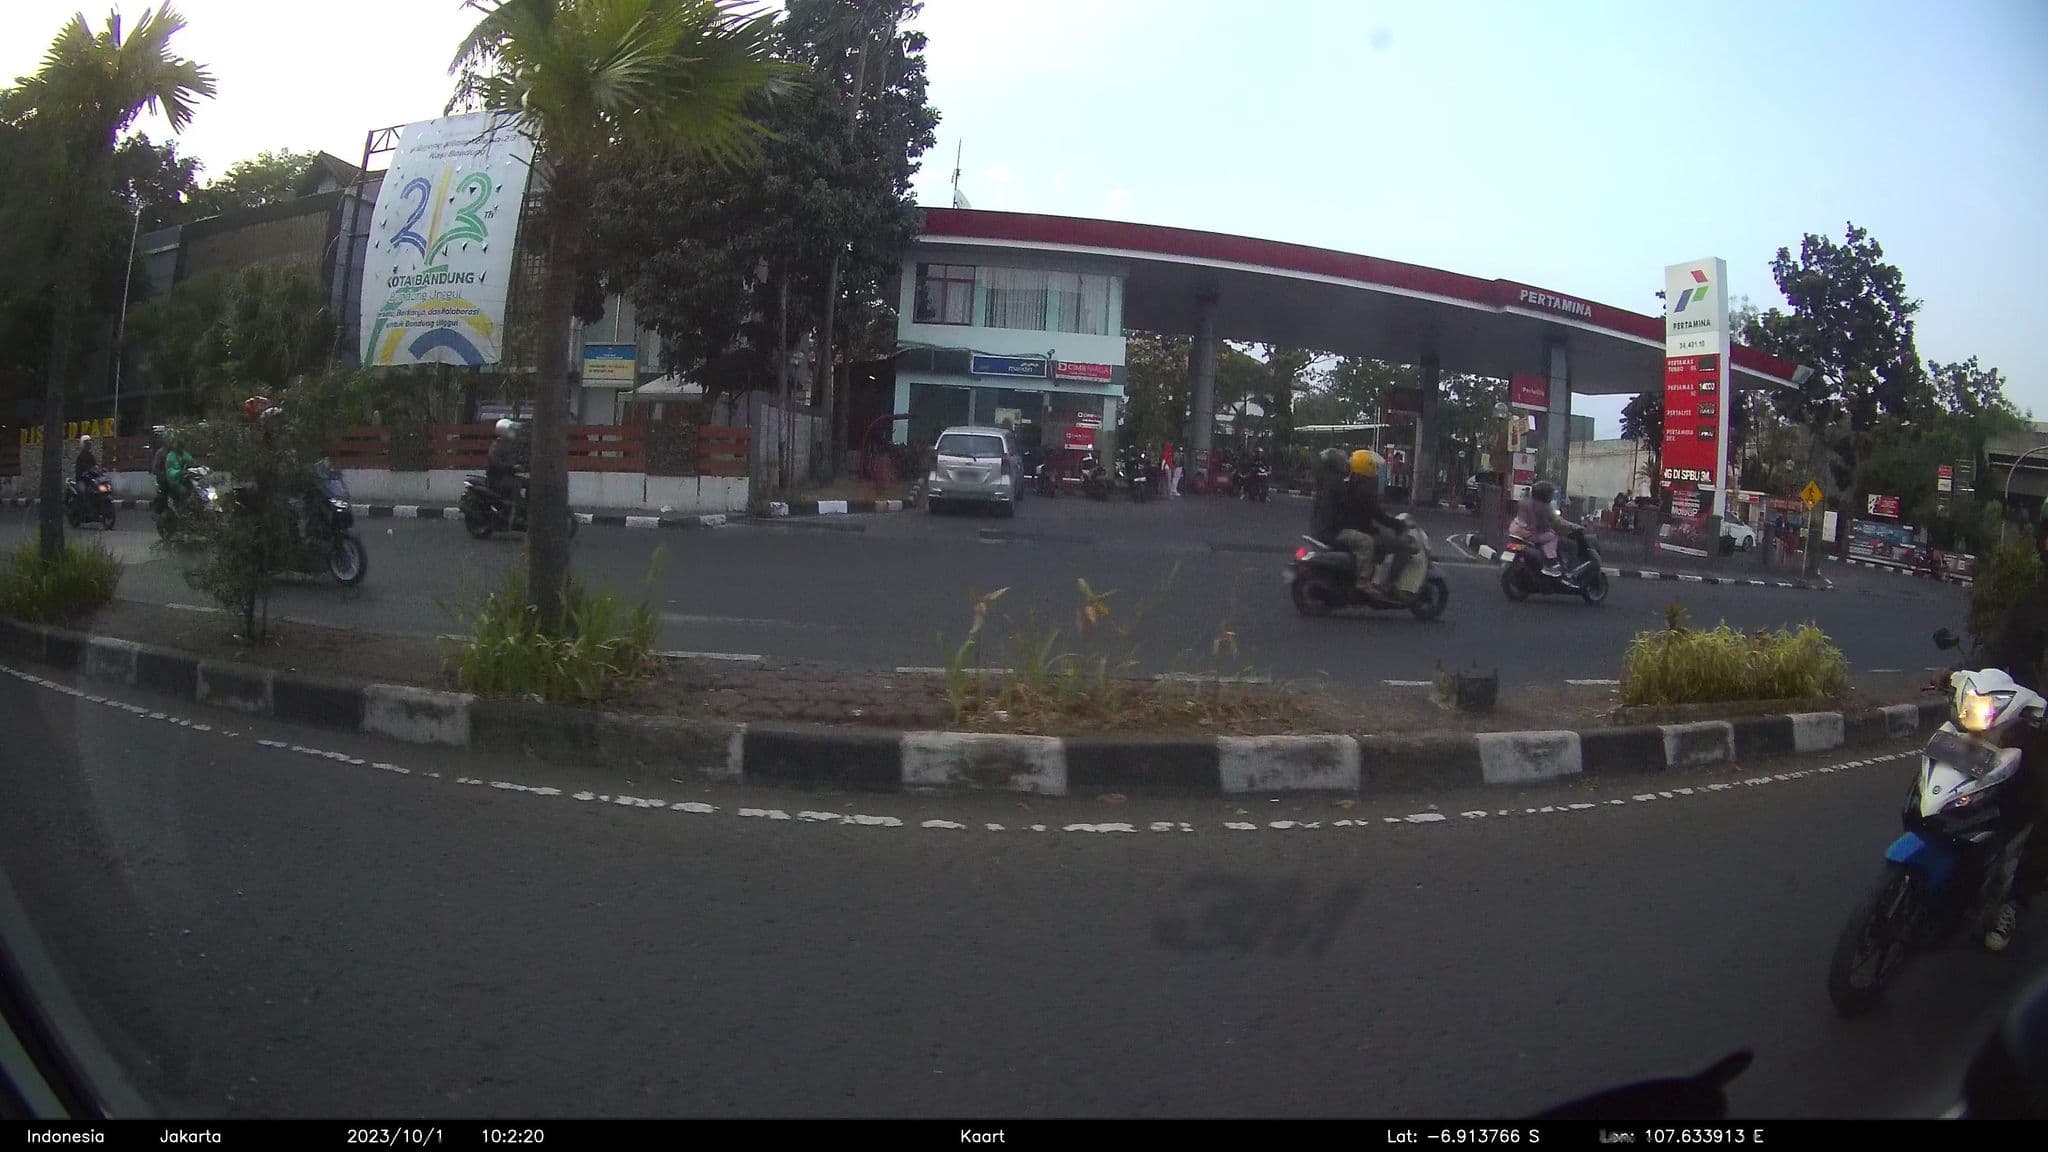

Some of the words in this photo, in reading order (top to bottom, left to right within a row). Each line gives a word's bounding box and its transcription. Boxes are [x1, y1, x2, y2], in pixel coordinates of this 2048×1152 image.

[415, 271, 474, 286] BANDUNG
[1520, 289, 1592, 318] PERTAMINA
[1673, 319, 1711, 330] PERTAMINA
[1008, 365, 1033, 373] mandiri
[1681, 469, 1700, 481] SPBU
